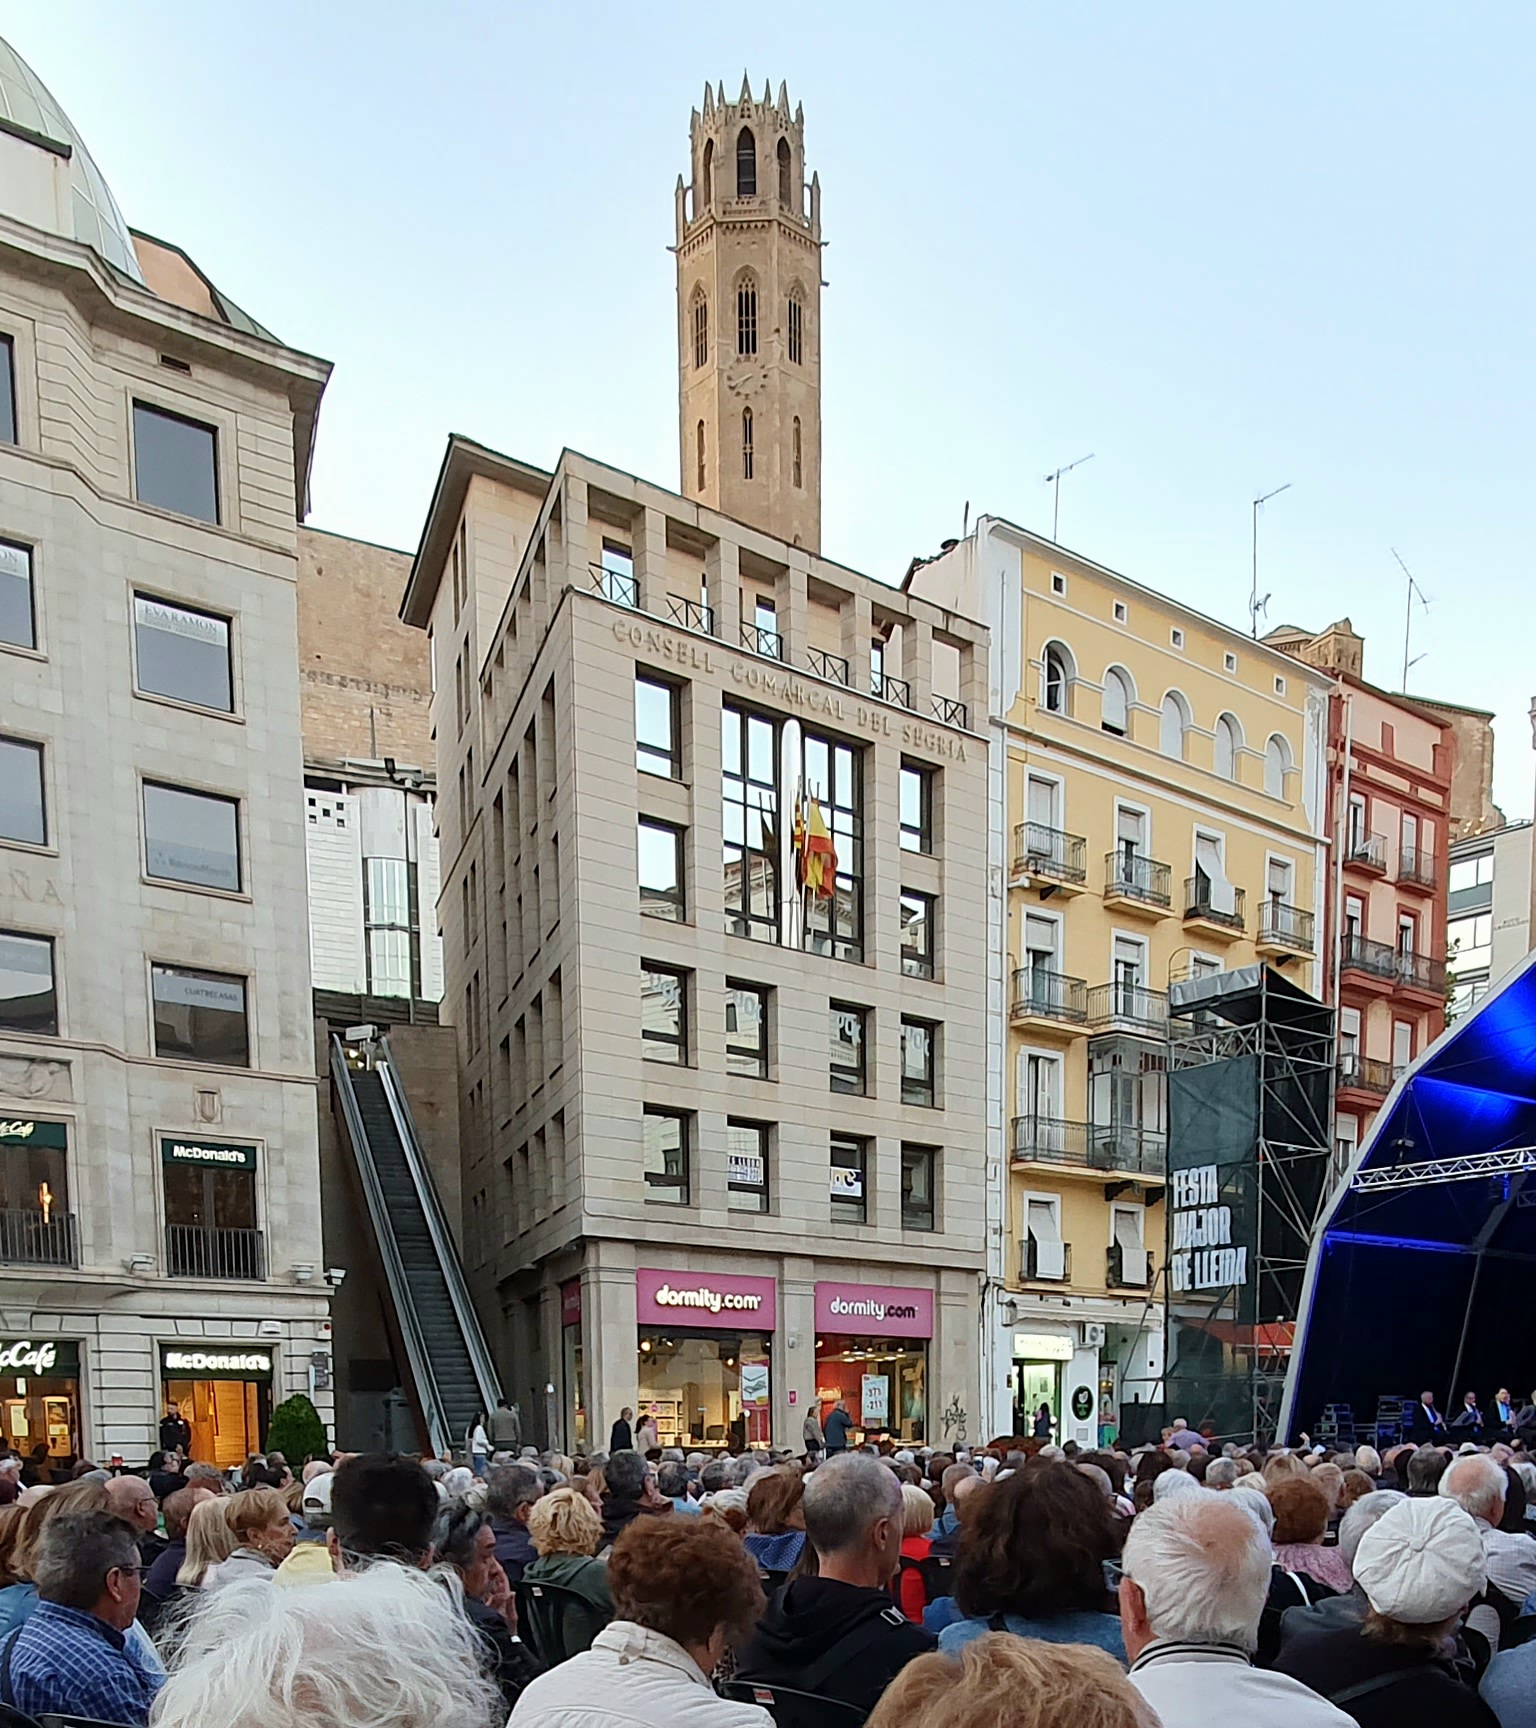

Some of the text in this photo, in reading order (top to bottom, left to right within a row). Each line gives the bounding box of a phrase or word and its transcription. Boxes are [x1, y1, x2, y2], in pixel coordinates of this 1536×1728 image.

[613, 620, 715, 674] CONSELL
[731, 661, 845, 721] COMARCAL
[857, 706, 892, 736] DEL
[173, 1144, 246, 1163] McDonald's
[1172, 1164, 1219, 1209] FESTA
[1172, 1205, 1232, 1251] MAJOR
[1171, 1246, 1247, 1292] DE LLEIDA
[655, 1284, 762, 1313] dormity.com
[830, 1296, 918, 1321] dormity.com
[165, 1352, 271, 1371] McDonald's
